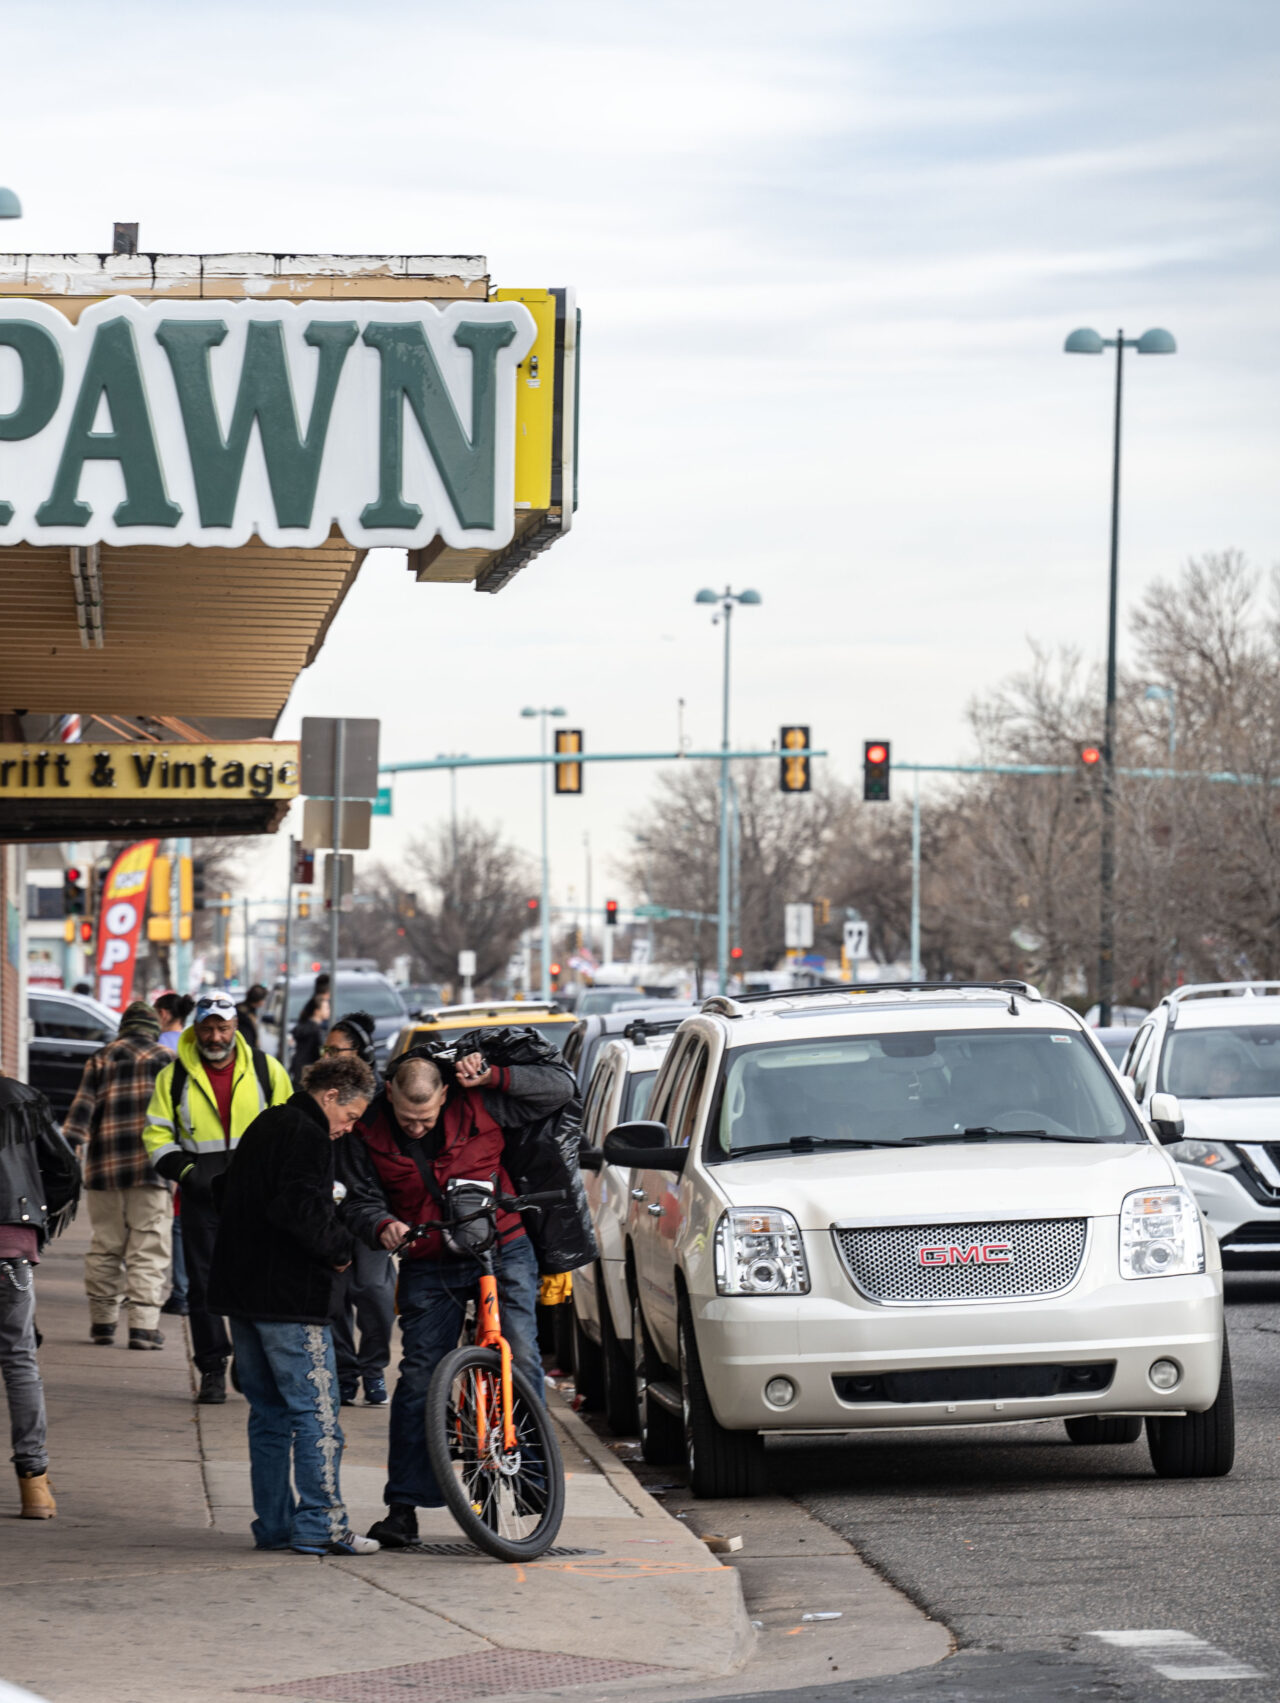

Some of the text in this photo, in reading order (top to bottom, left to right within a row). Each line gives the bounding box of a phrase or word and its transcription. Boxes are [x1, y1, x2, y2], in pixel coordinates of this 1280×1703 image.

[91, 751, 116, 787] &
[132, 751, 298, 798] Vintage
[919, 1244, 1010, 1265] GMC
